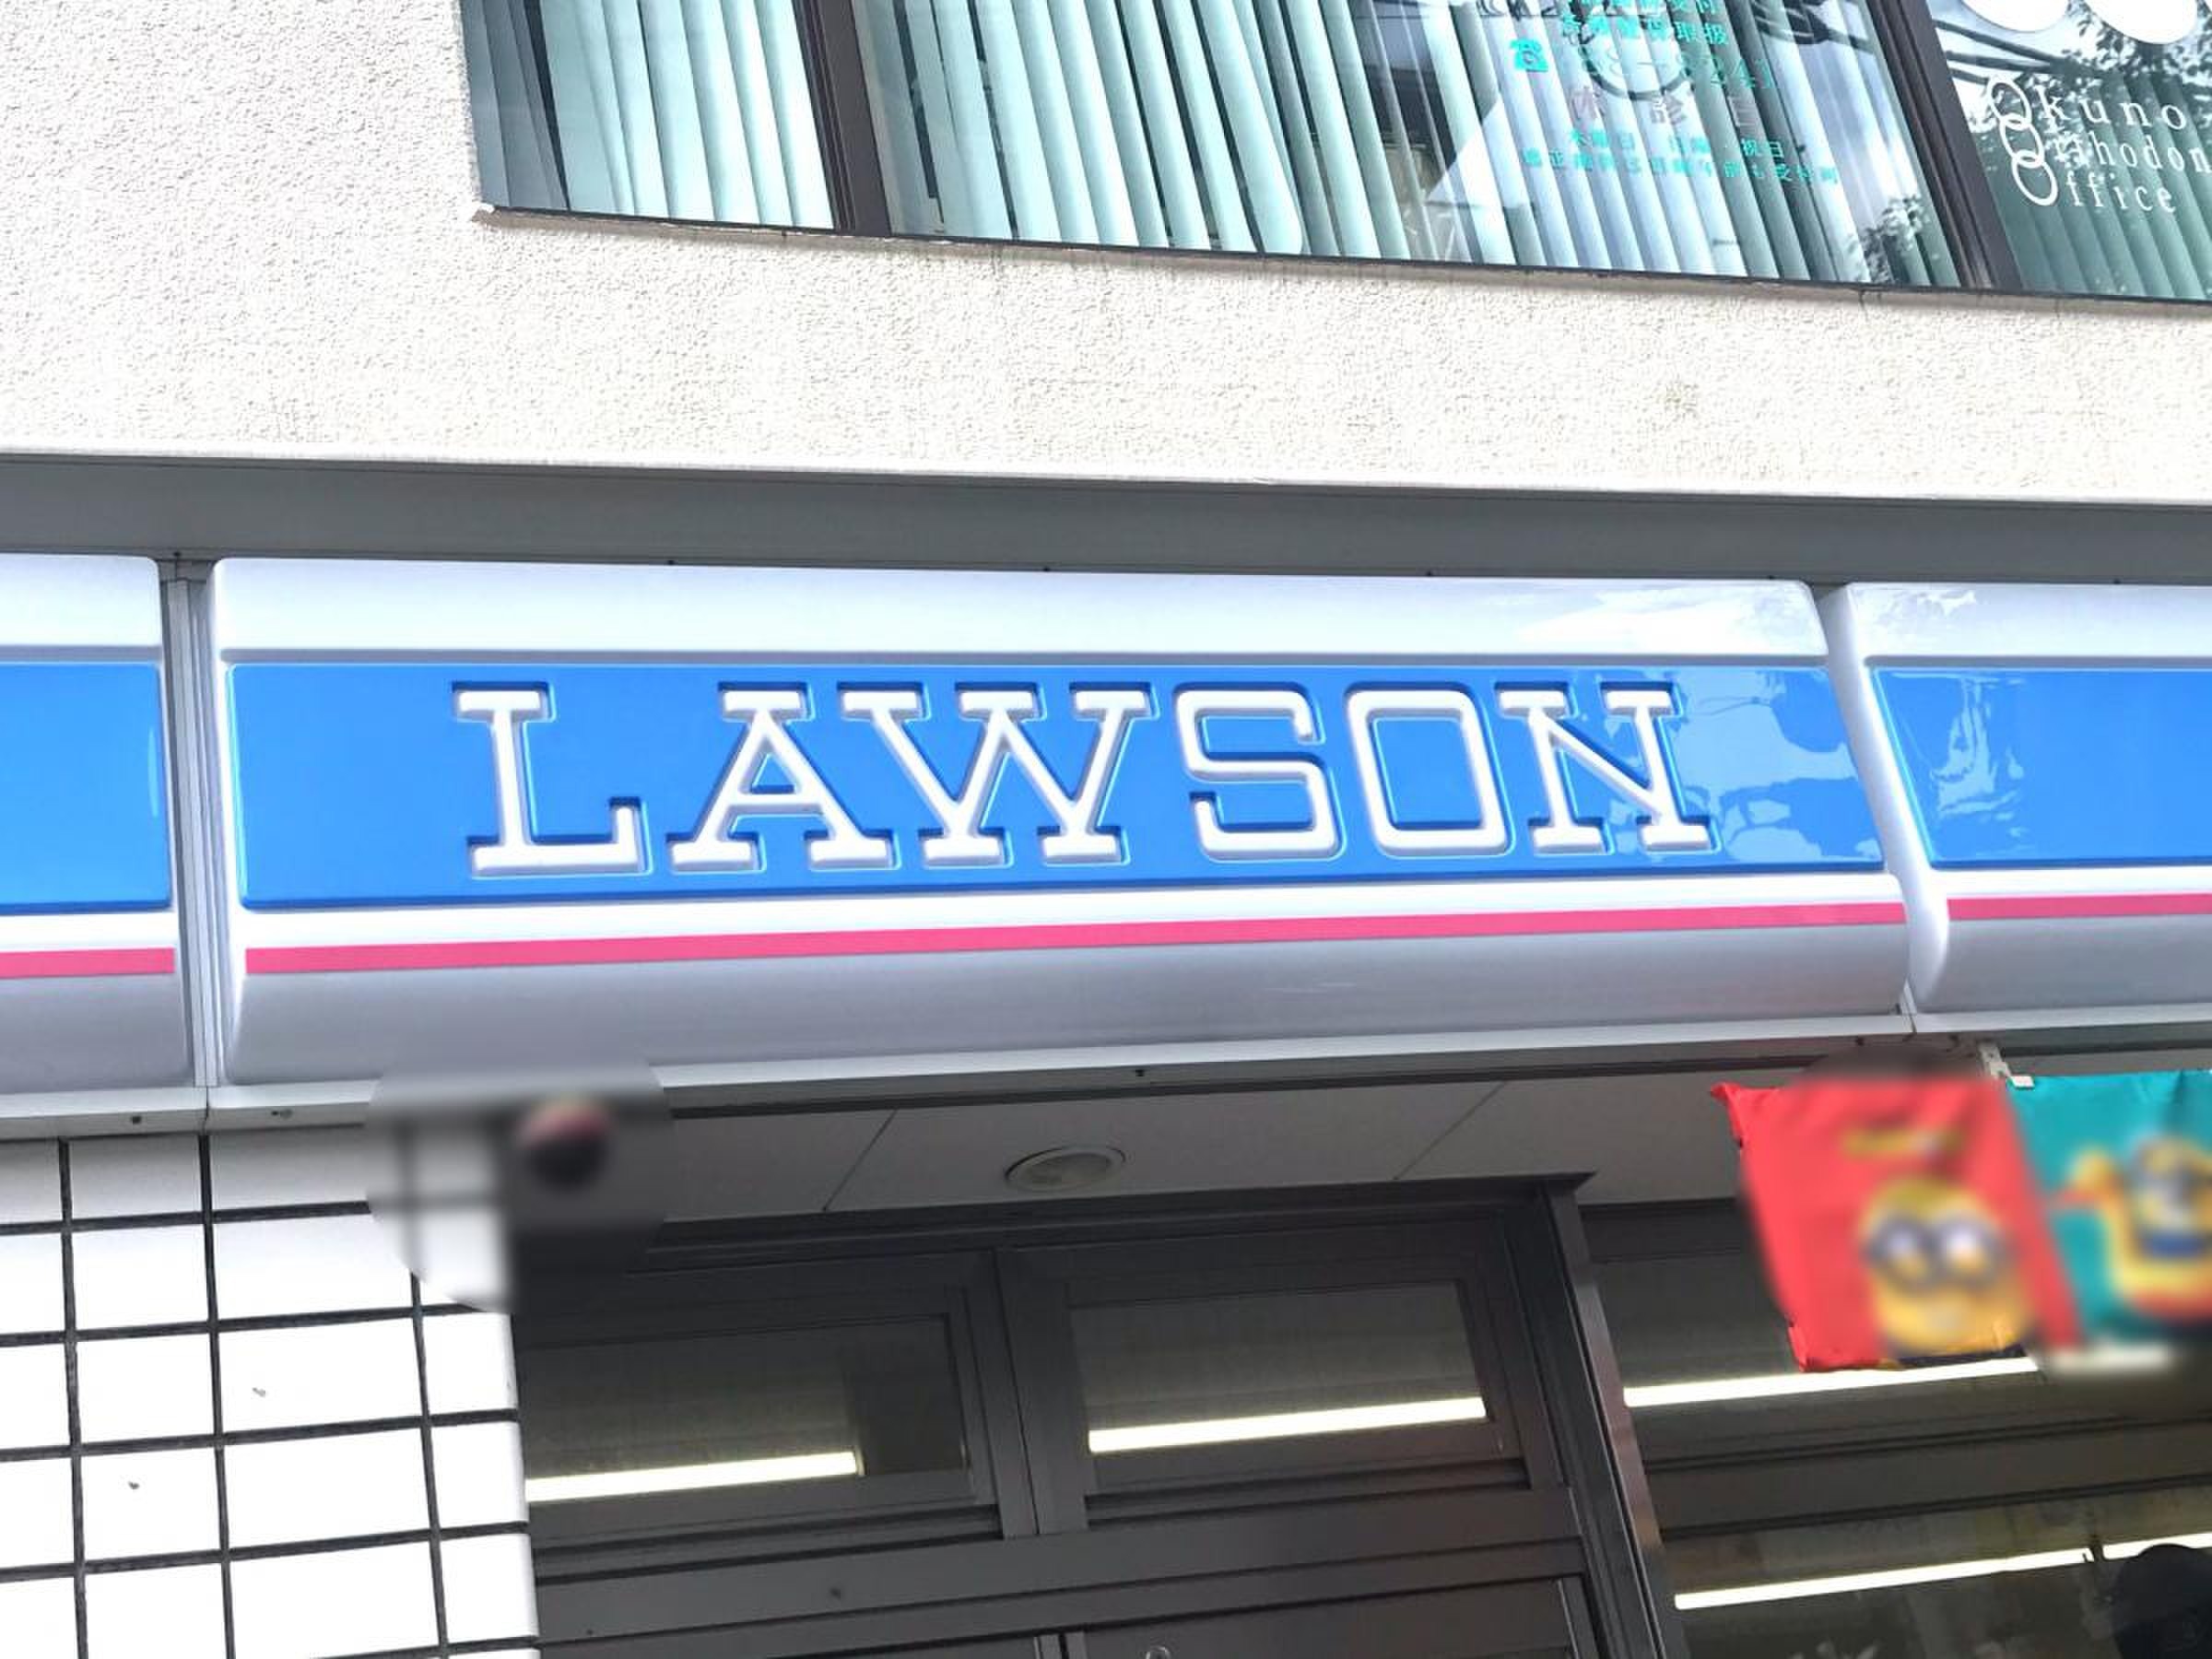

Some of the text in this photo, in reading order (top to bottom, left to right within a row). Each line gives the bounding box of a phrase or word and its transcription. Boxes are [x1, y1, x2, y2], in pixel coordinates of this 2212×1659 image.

[1986, 76, 2187, 132] Okuno
[2010, 148, 2176, 213] Office
[452, 681, 1718, 877] LAWSON
